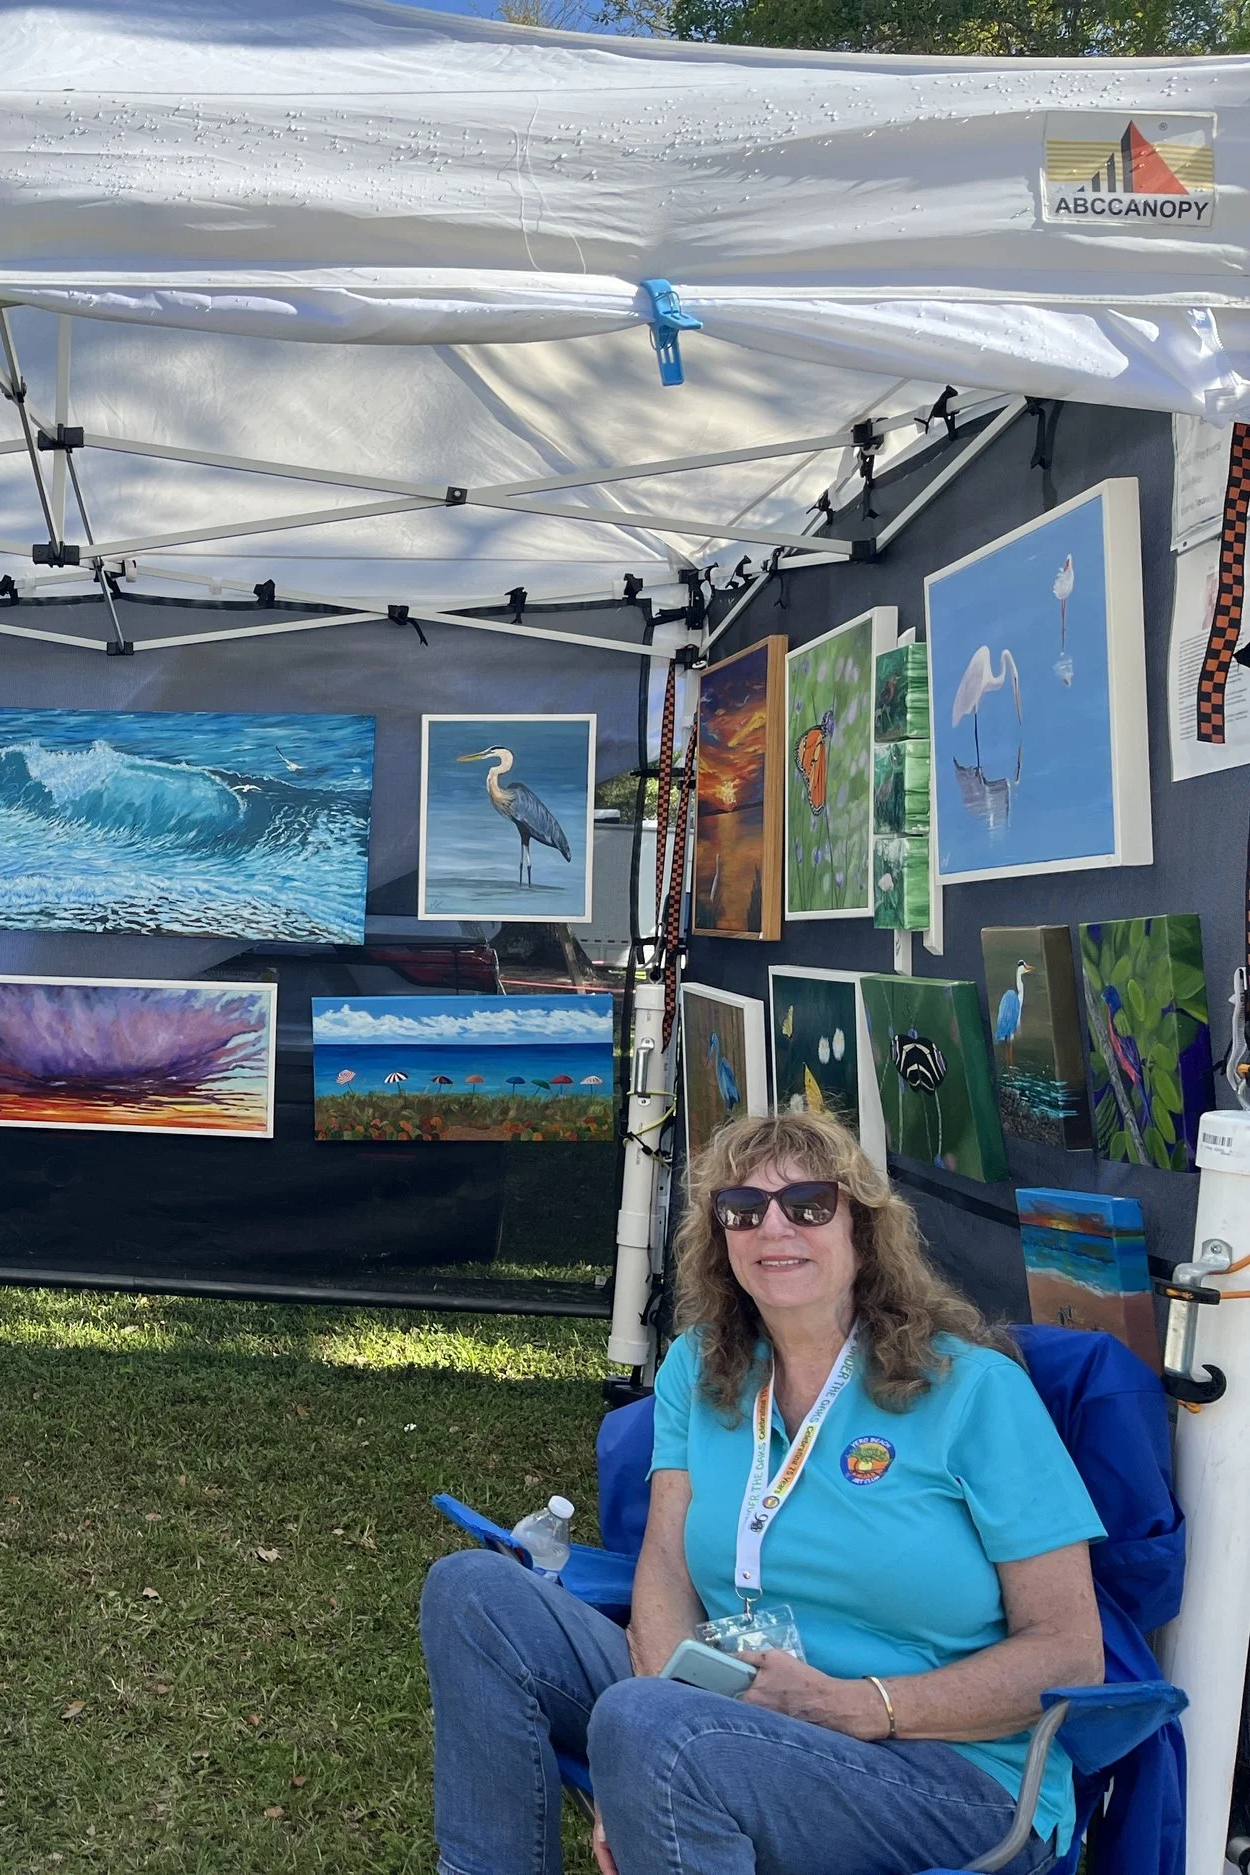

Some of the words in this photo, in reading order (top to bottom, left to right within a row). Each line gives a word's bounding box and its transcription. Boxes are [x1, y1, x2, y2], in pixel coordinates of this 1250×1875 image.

[1055, 197, 1209, 220] ABCCANOPY
[825, 1382, 844, 1399] THE
[810, 1400, 831, 1423] OAKS
[756, 1442, 767, 1470] OAKS
[792, 1426, 814, 1465] Celebrating
[751, 1473, 763, 1493] THE
[774, 1477, 789, 1494] Years
